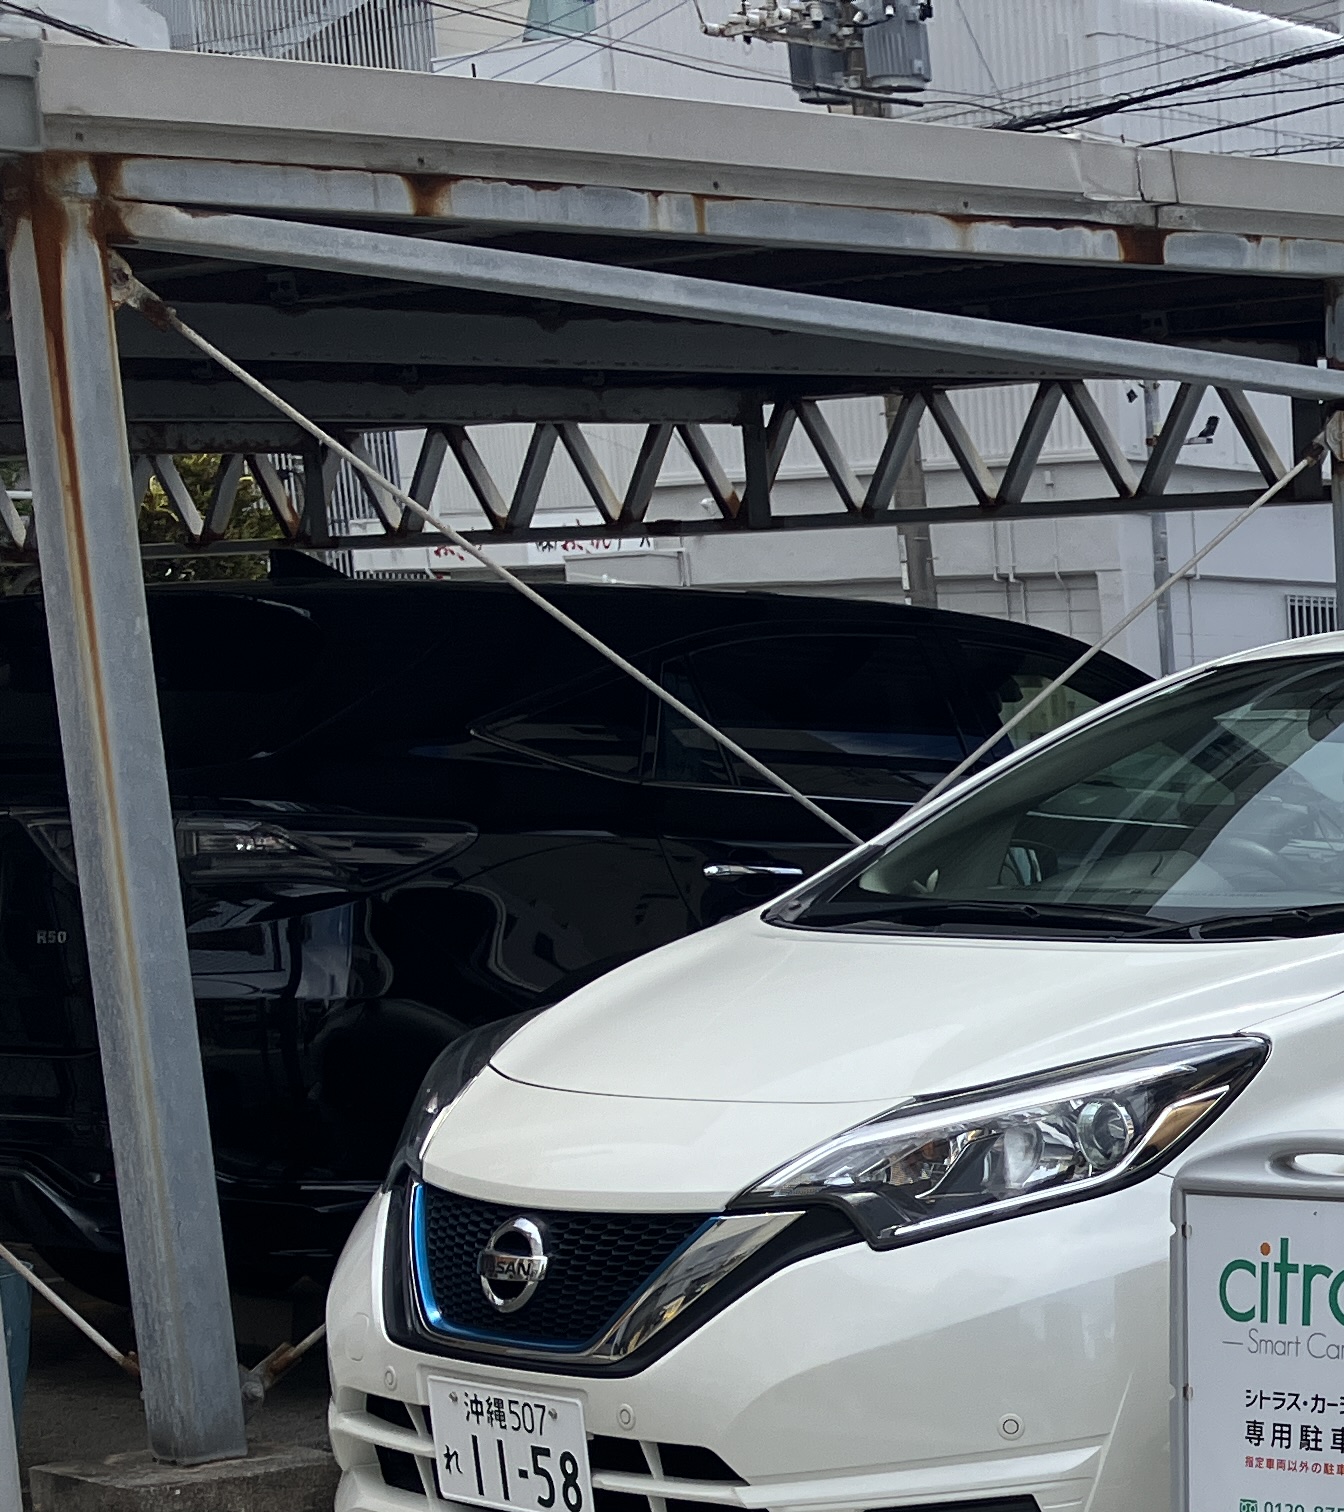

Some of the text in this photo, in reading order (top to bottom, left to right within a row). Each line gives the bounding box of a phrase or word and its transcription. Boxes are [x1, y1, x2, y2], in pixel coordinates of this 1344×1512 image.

[1247, 1328, 1301, 1358] Smart
[443, 1434, 582, 1512] れ 11-58
